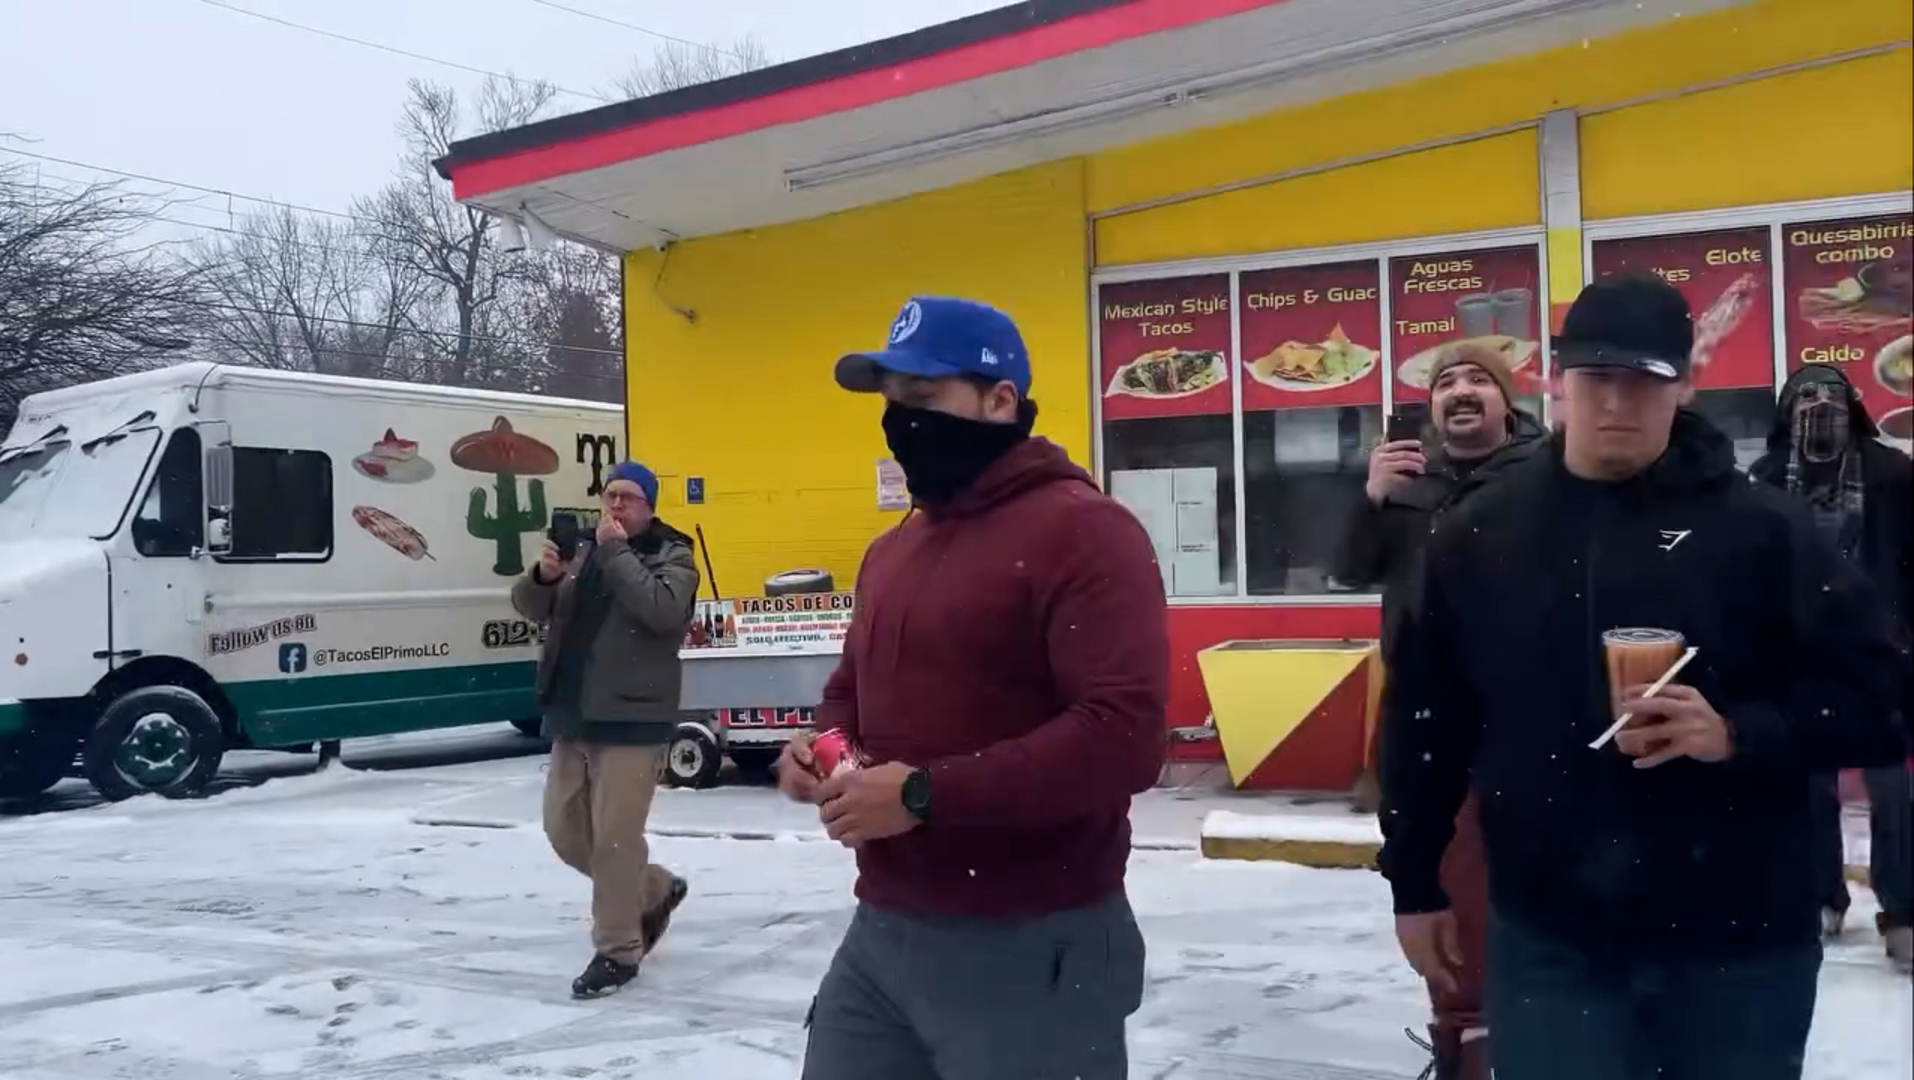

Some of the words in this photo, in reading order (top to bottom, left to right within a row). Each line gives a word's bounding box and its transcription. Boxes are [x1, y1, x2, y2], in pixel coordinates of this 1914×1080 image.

[1791, 221, 1914, 246] Quesabirria
[1705, 247, 1762, 266] Elote
[1815, 245, 1895, 264] combo
[1411, 258, 1473, 278] Aguas
[1404, 275, 1483, 294] Frescas
[1104, 304, 1175, 321] Mexican
[1181, 297, 1229, 317] Style
[1247, 293, 1298, 314] Chips
[1303, 290, 1319, 304] &
[1327, 286, 1377, 303] Guac
[1140, 320, 1194, 337] Tacos
[1396, 316, 1456, 335] Tamal
[1801, 345, 1865, 364] Caldo
[741, 598, 796, 613] TACOS
[803, 596, 822, 610] DE
[831, 595, 853, 609] CO
[209, 624, 271, 656] Follow
[271, 618, 293, 640] us
[313, 642, 450, 667] @TacosElPrimoLLC
